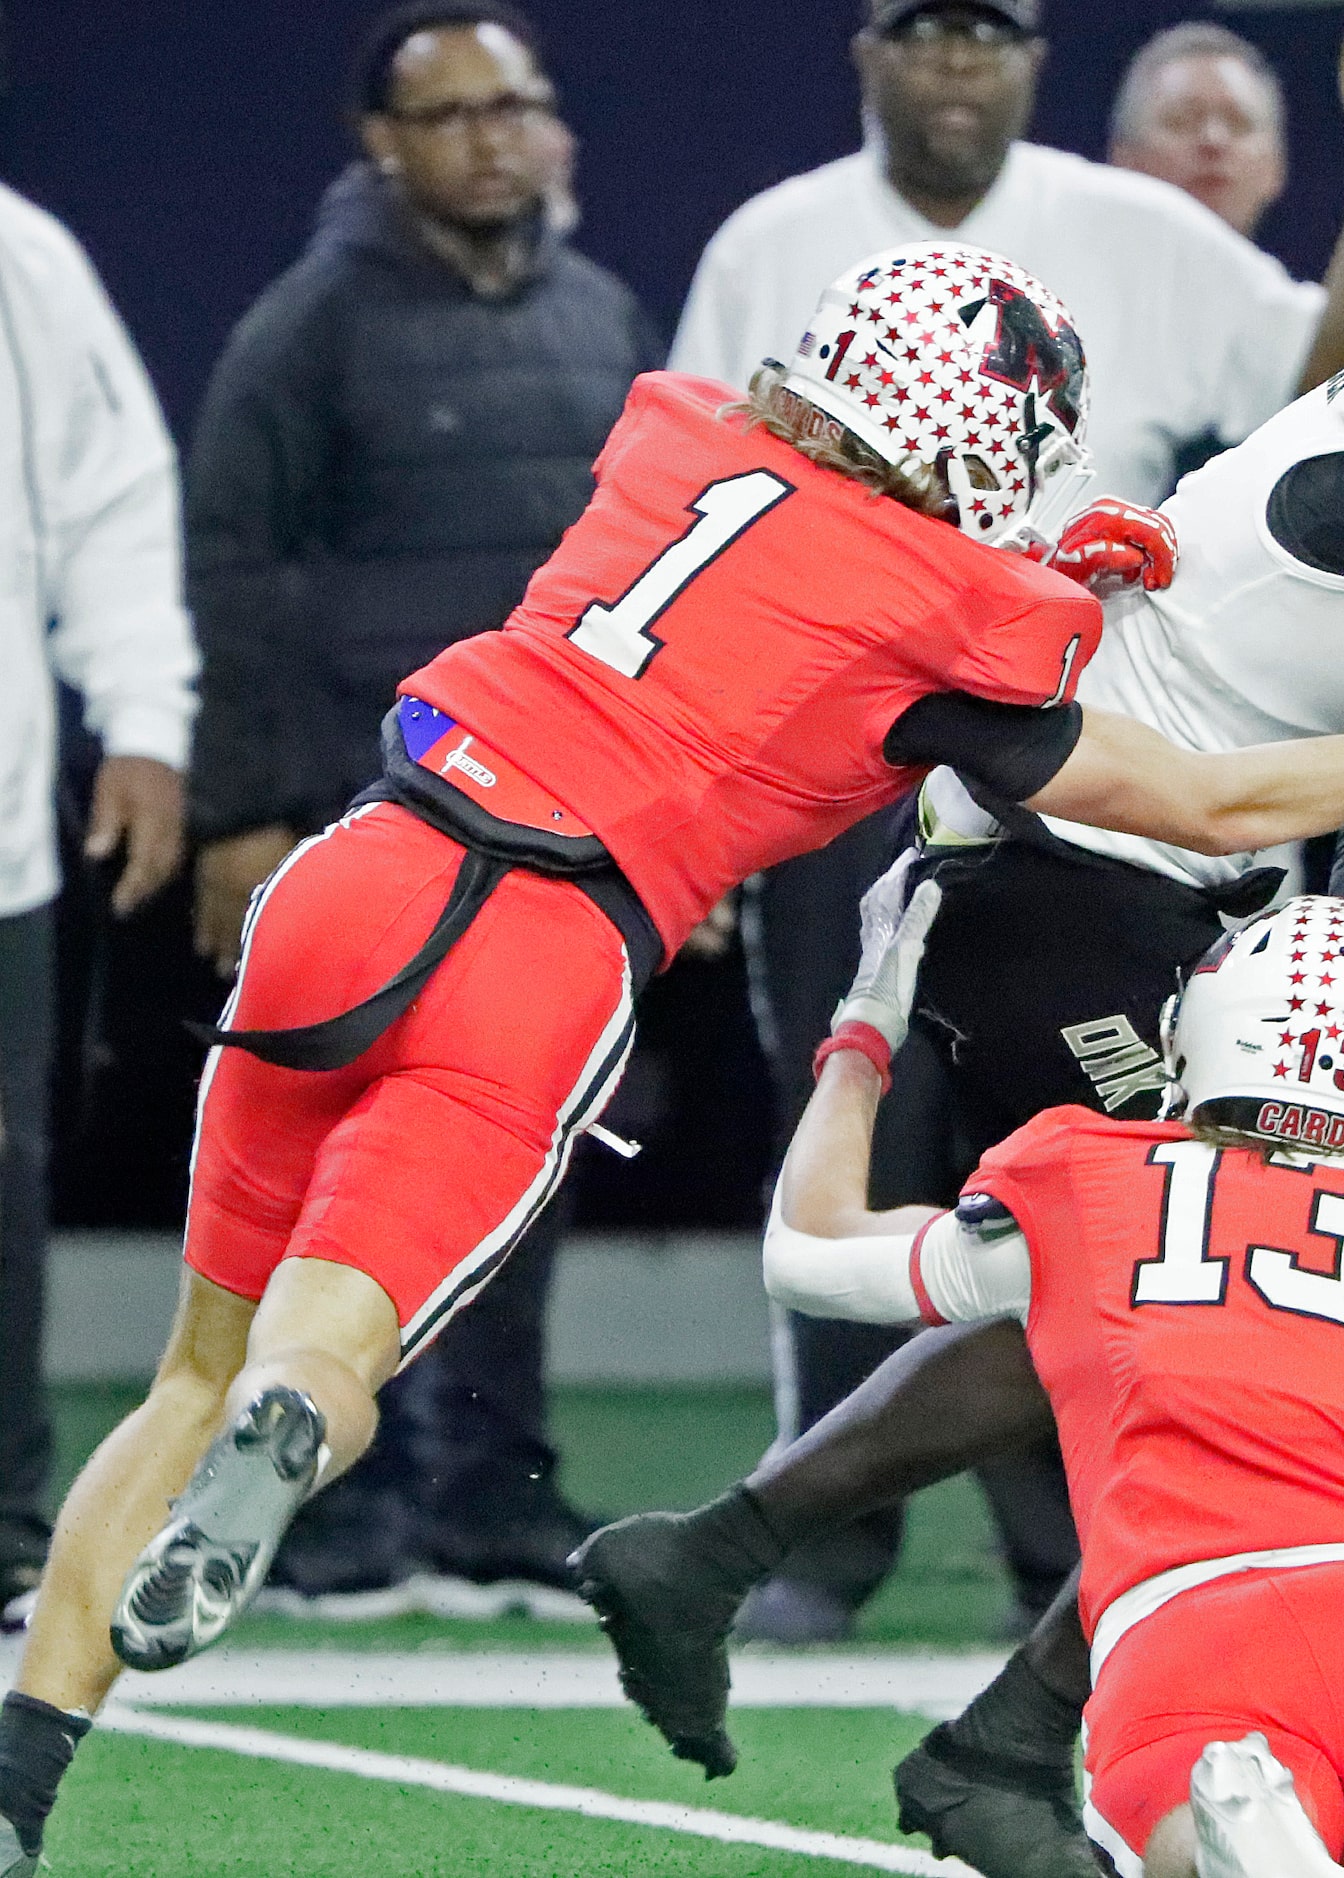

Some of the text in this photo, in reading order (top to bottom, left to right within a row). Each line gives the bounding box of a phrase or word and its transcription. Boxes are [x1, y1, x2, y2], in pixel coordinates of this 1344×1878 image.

[826, 330, 857, 381] 1
[563, 467, 798, 681] 1
[1040, 633, 1081, 709] 1
